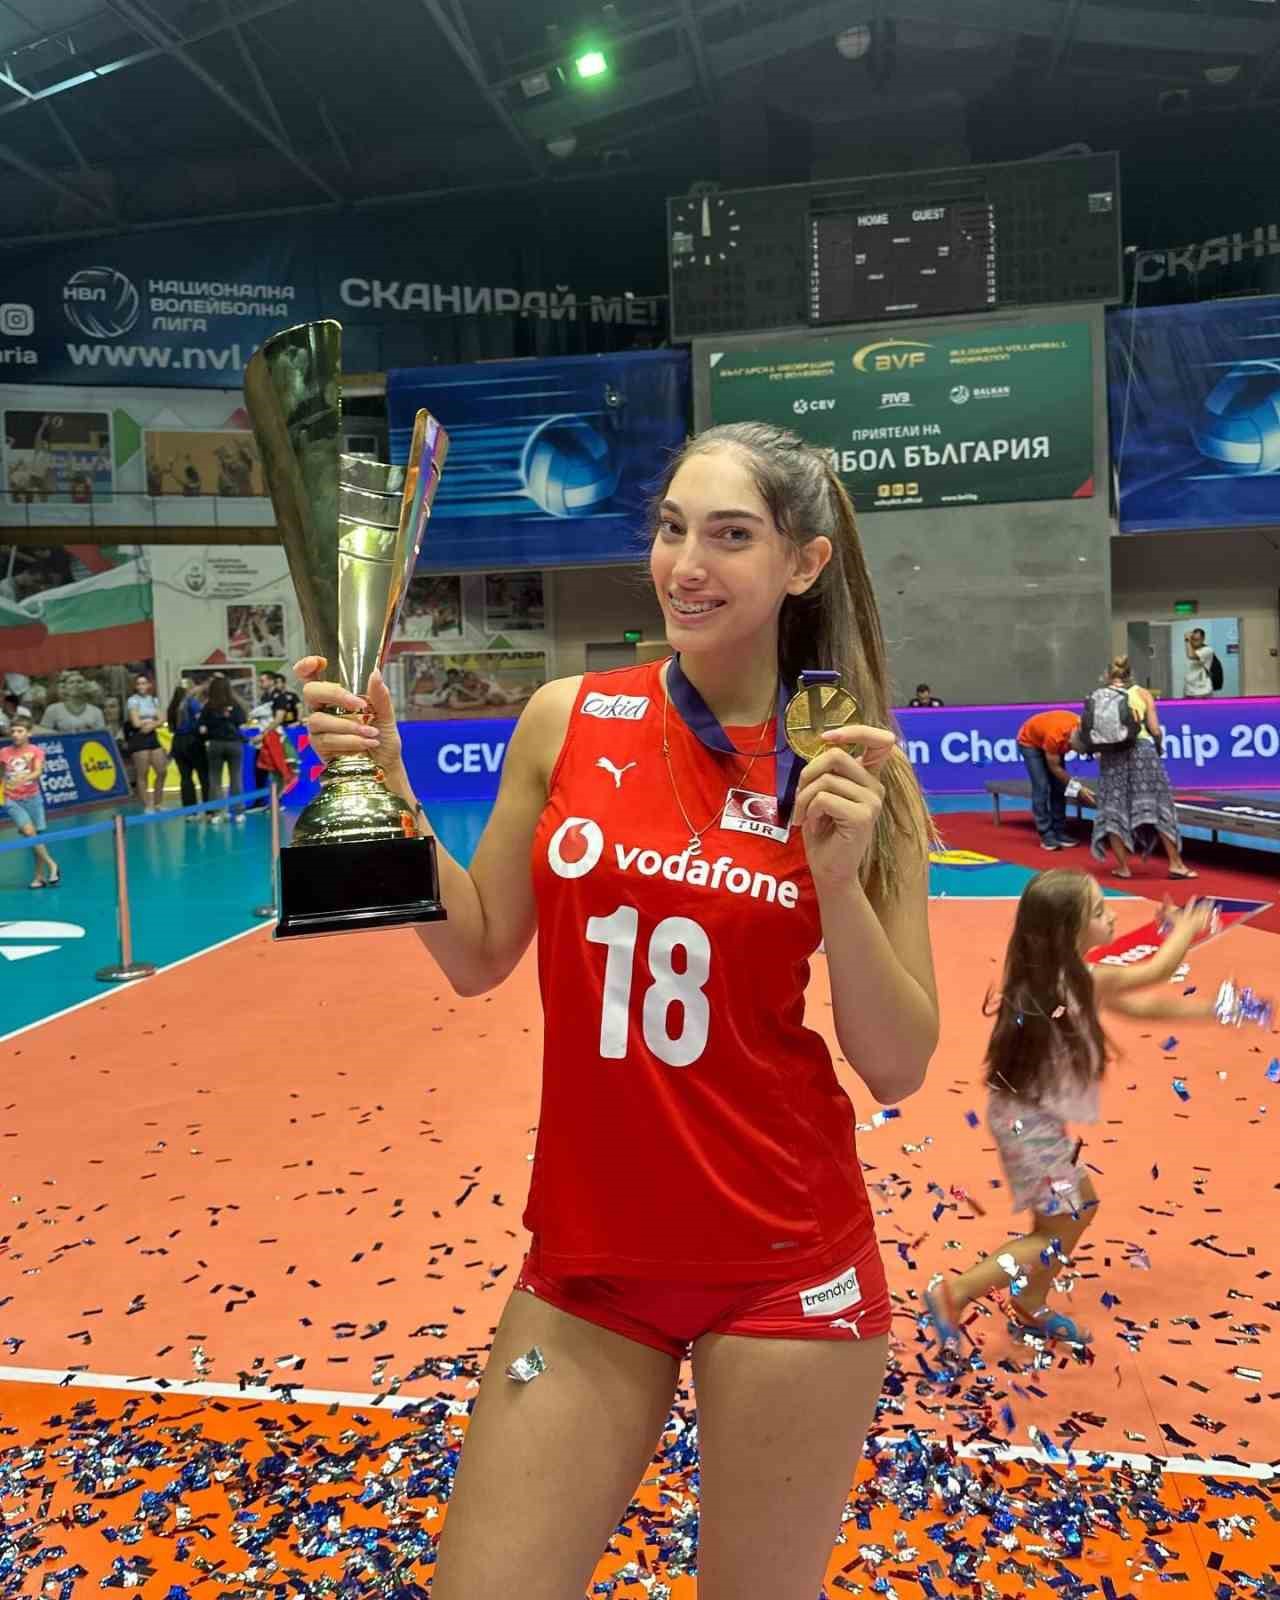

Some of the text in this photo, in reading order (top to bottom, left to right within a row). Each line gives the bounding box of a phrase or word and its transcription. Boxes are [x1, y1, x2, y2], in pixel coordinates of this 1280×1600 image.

[857, 213, 889, 226] HOME
[912, 208, 946, 222] GUEST
[63, 286, 107, 302] НВЛ
[149, 279, 295, 300] НАЦИОНАЛНА
[339, 277, 577, 321] СКАНИРАЙ
[150, 296, 289, 317] ВОЛЕЙБОЛНА
[152, 315, 208, 333] ЛИГА
[66, 343, 260, 371] www.nvl.
[810, 399, 836, 410] CEV
[881, 392, 911, 405] FIVB
[852, 423, 941, 441] ПРИЯТЕЛИ НА
[904, 436, 1049, 468] БЪЛГАРИЯ
[582, 695, 648, 718] Orkid
[437, 742, 505, 774] CEV
[40, 771, 76, 792] Food
[737, 819, 774, 836] TUR
[614, 843, 800, 909] vodafone
[585, 904, 712, 1068] 18
[804, 1271, 857, 1307] trendyol
